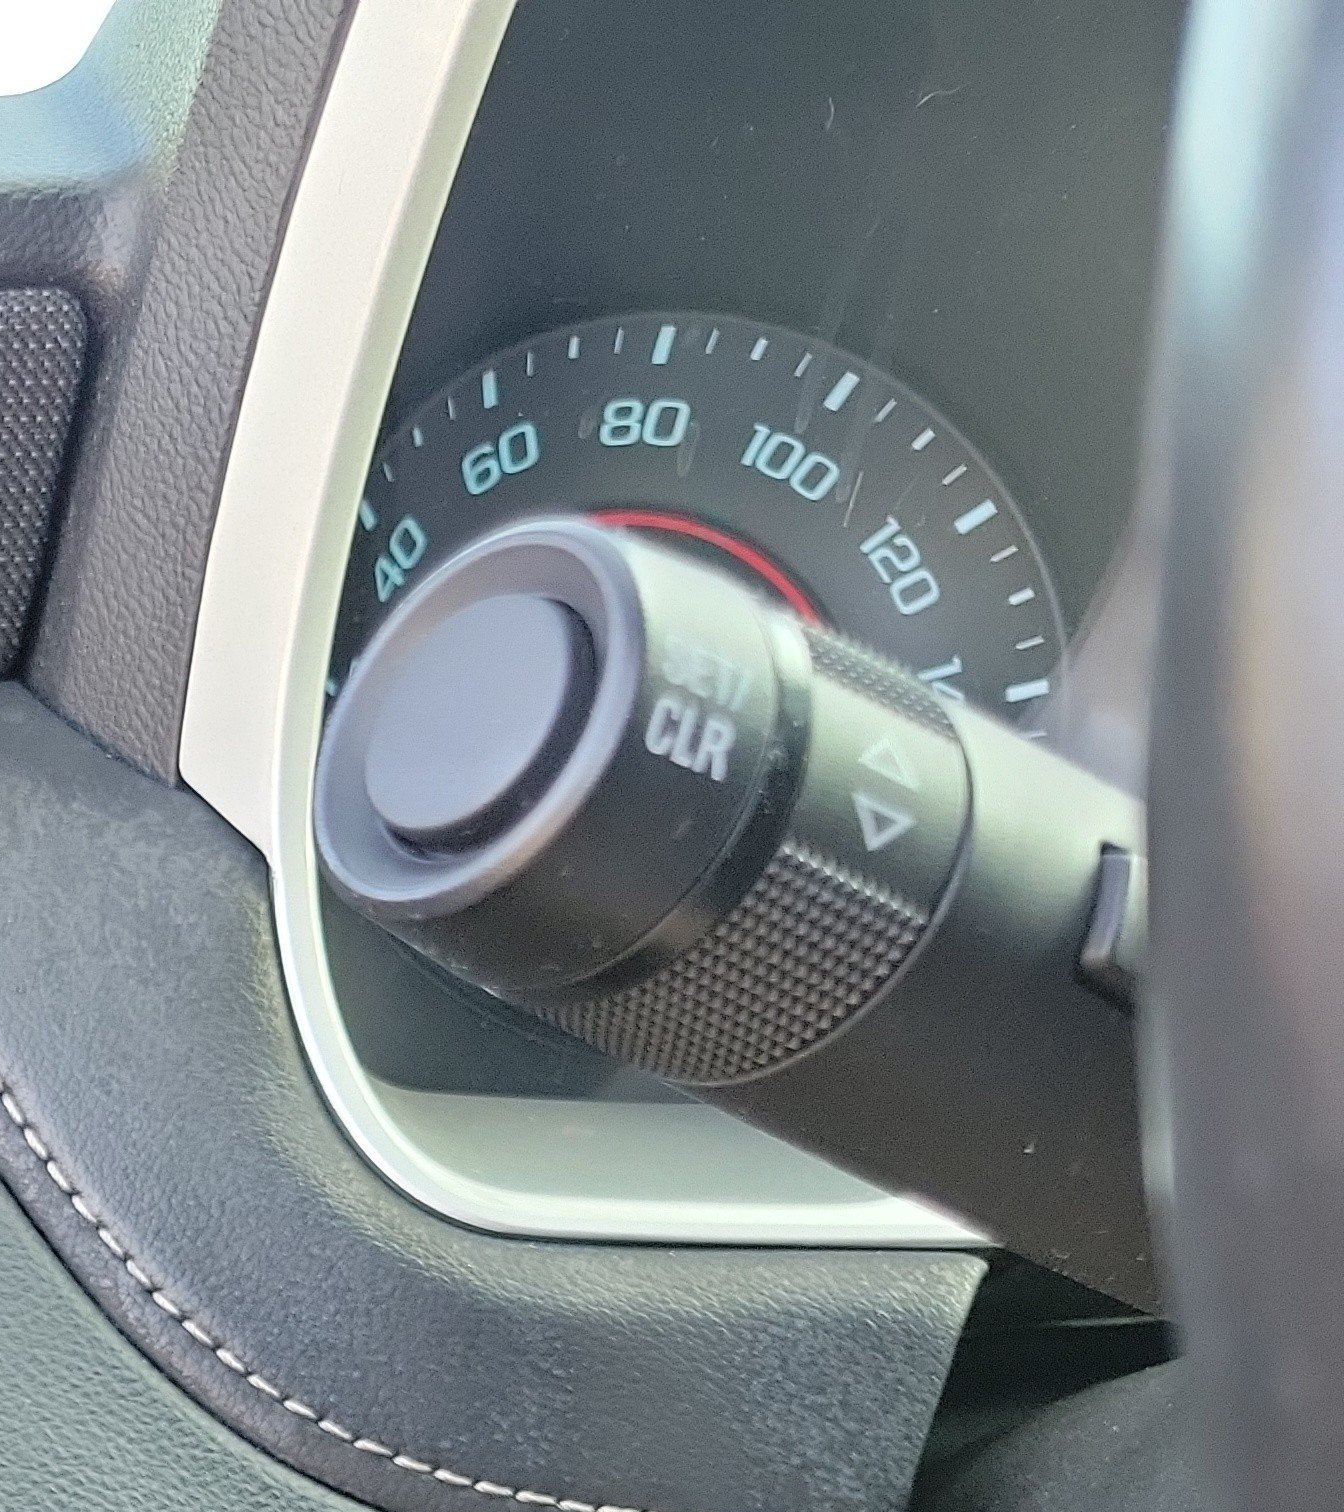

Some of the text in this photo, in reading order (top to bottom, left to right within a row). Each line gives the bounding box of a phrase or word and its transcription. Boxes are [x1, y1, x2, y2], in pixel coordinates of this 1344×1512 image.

[461, 425, 539, 493] 60
[599, 398, 689, 447] 80
[741, 424, 838, 500] 100
[375, 517, 426, 602] 40
[861, 517, 939, 614] 120
[645, 697, 737, 781] CLR
